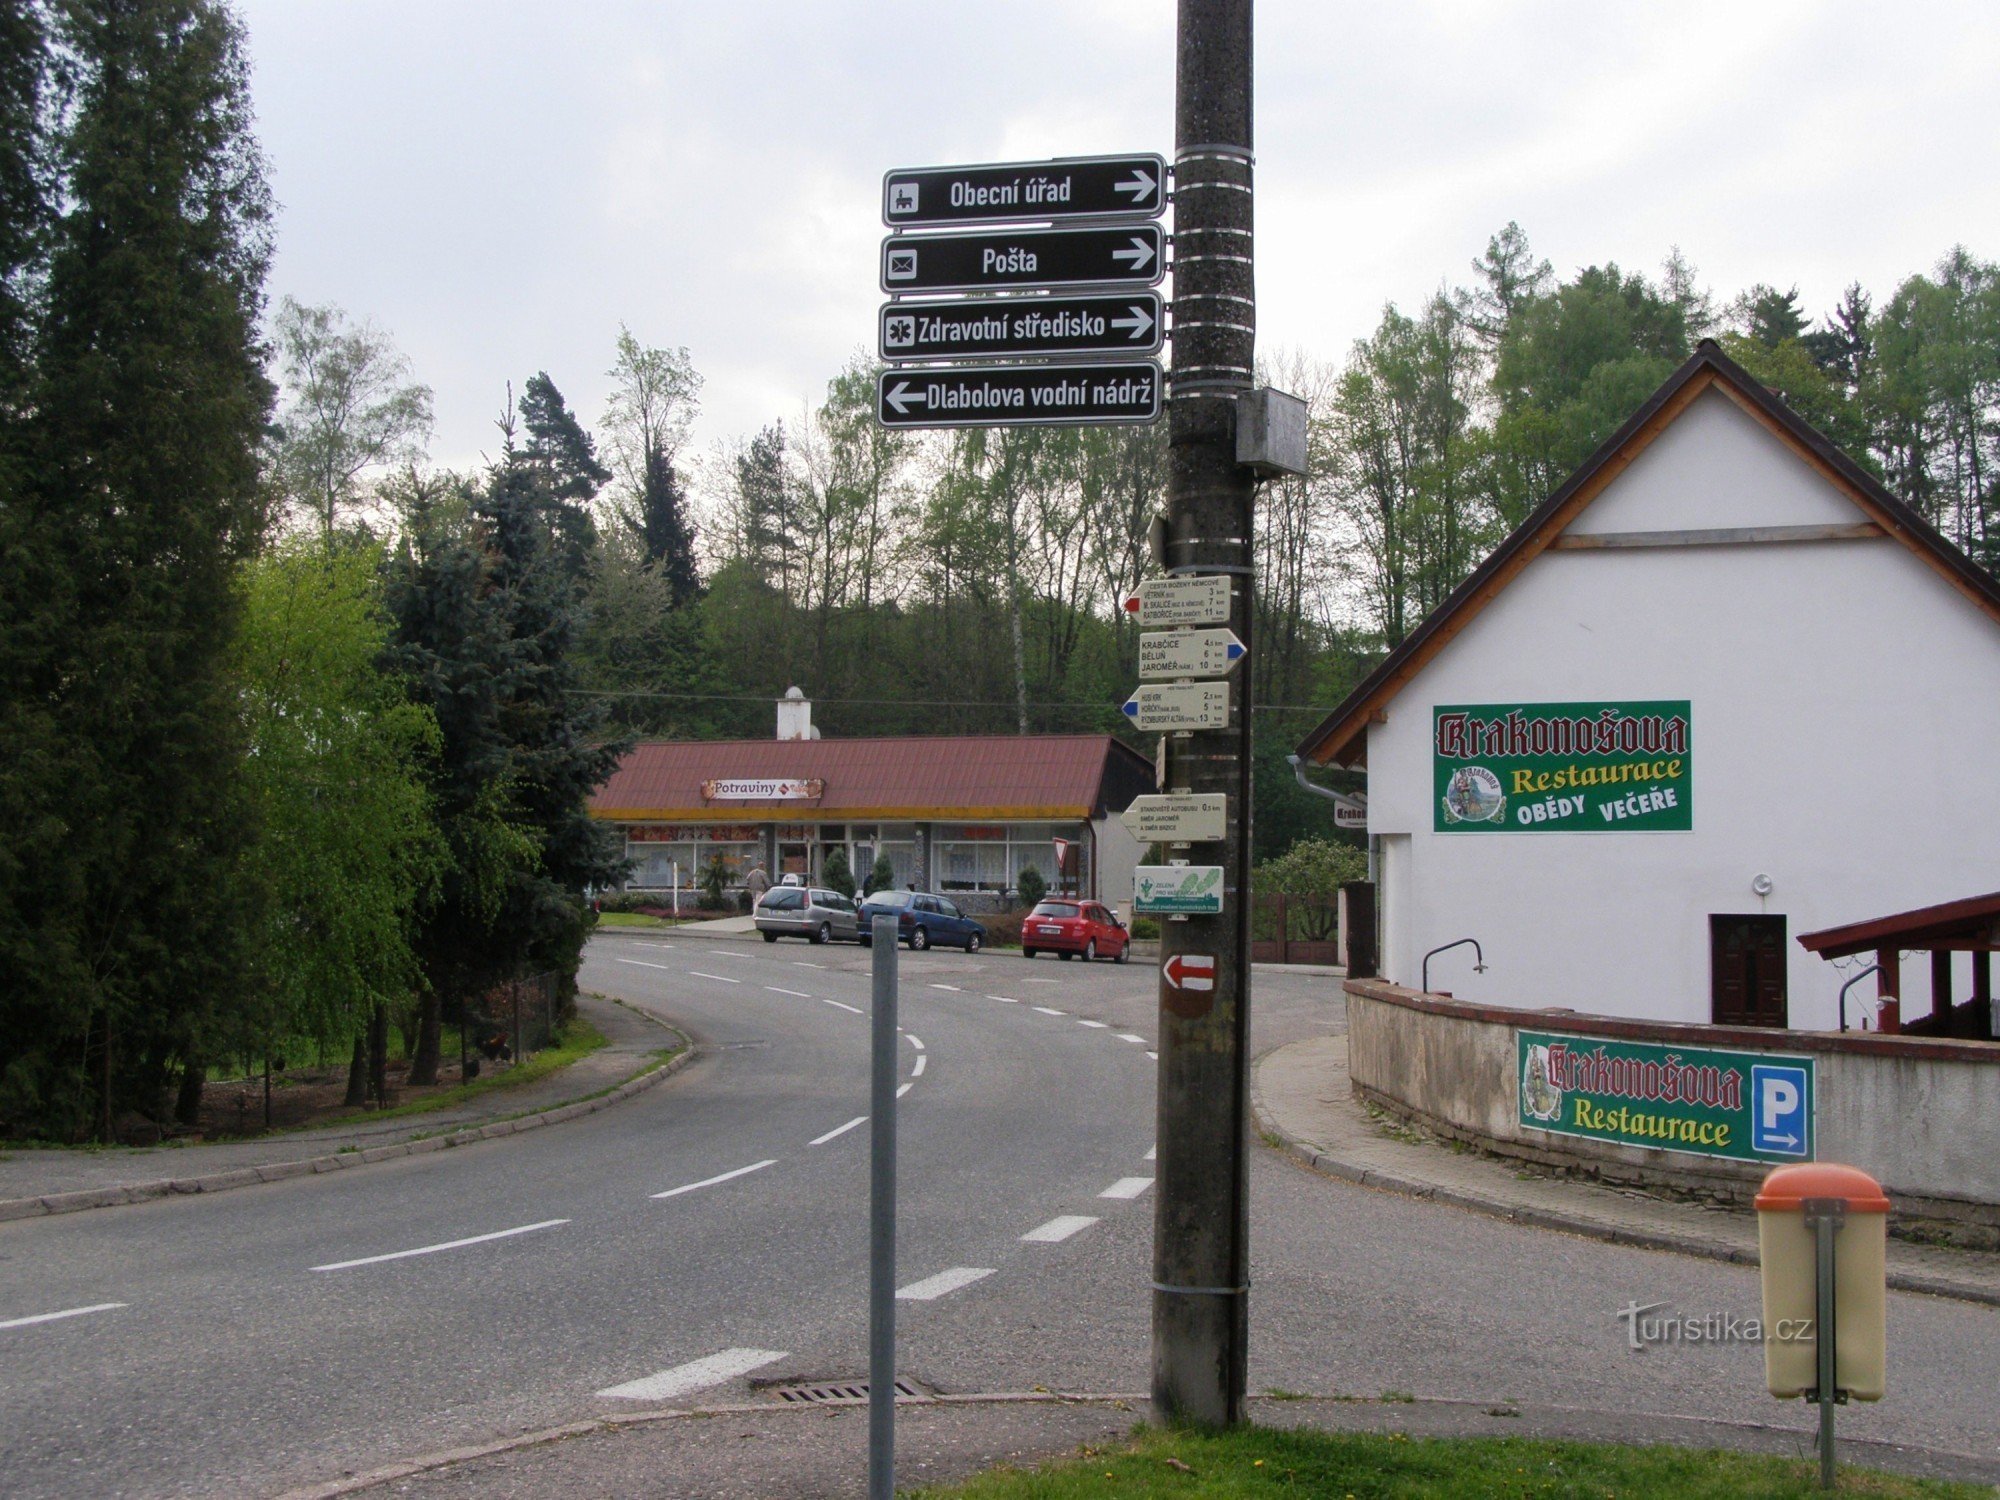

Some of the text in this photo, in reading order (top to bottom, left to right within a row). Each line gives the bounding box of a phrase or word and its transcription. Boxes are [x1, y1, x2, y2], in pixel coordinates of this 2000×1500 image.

[951, 177, 1071, 207] Obecní úřad
[983, 248, 1037, 273] Pošta
[918, 311, 1105, 342] Zdravotní středisko
[928, 377, 1150, 409] Dlabolova vodní nádrž
[1209, 588, 1214, 596] 3
[1205, 608, 1213, 616] 11
[1142, 639, 1179, 649] KRABČICE
[1204, 650, 1209, 658] 6
[1142, 661, 1178, 671] JAROMĚŘ
[1200, 661, 1208, 669] 10
[1200, 714, 1208, 722] 13
[1204, 703, 1209, 711] 5
[1436, 709, 1688, 758] Krakonošova
[715, 781, 776, 796] Potraviny
[1511, 759, 1684, 794] Restaurace
[1517, 786, 1678, 824] OBĚDY VEČEŘE
[1548, 1043, 1743, 1111] Krakonošova
[1762, 1078, 1799, 1128] P
[1574, 1098, 1732, 1147] Restaurace
